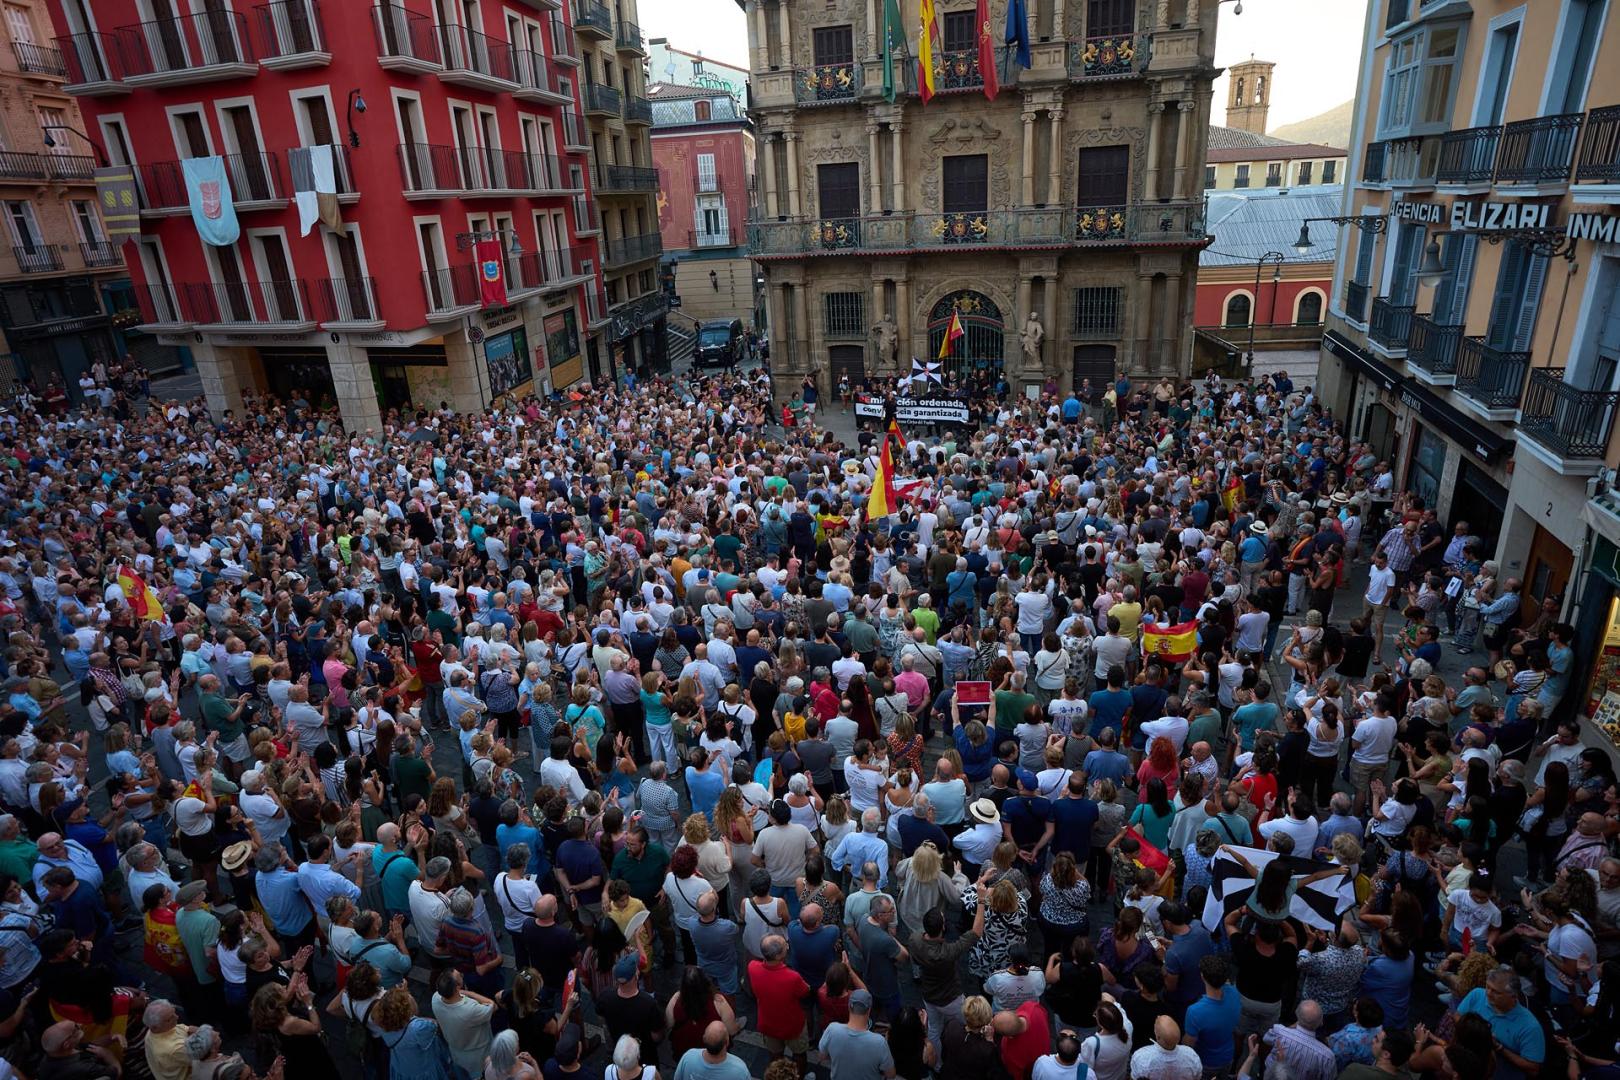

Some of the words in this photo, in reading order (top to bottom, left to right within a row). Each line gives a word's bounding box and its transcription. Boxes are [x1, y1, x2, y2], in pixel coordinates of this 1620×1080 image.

[1390, 201, 1440, 223] AGENCIA
[1451, 201, 1550, 230] ELIZARI
[920, 398, 966, 409] ordenada,
[913, 407, 963, 418] garantizada
[1546, 502, 1553, 516] 2
